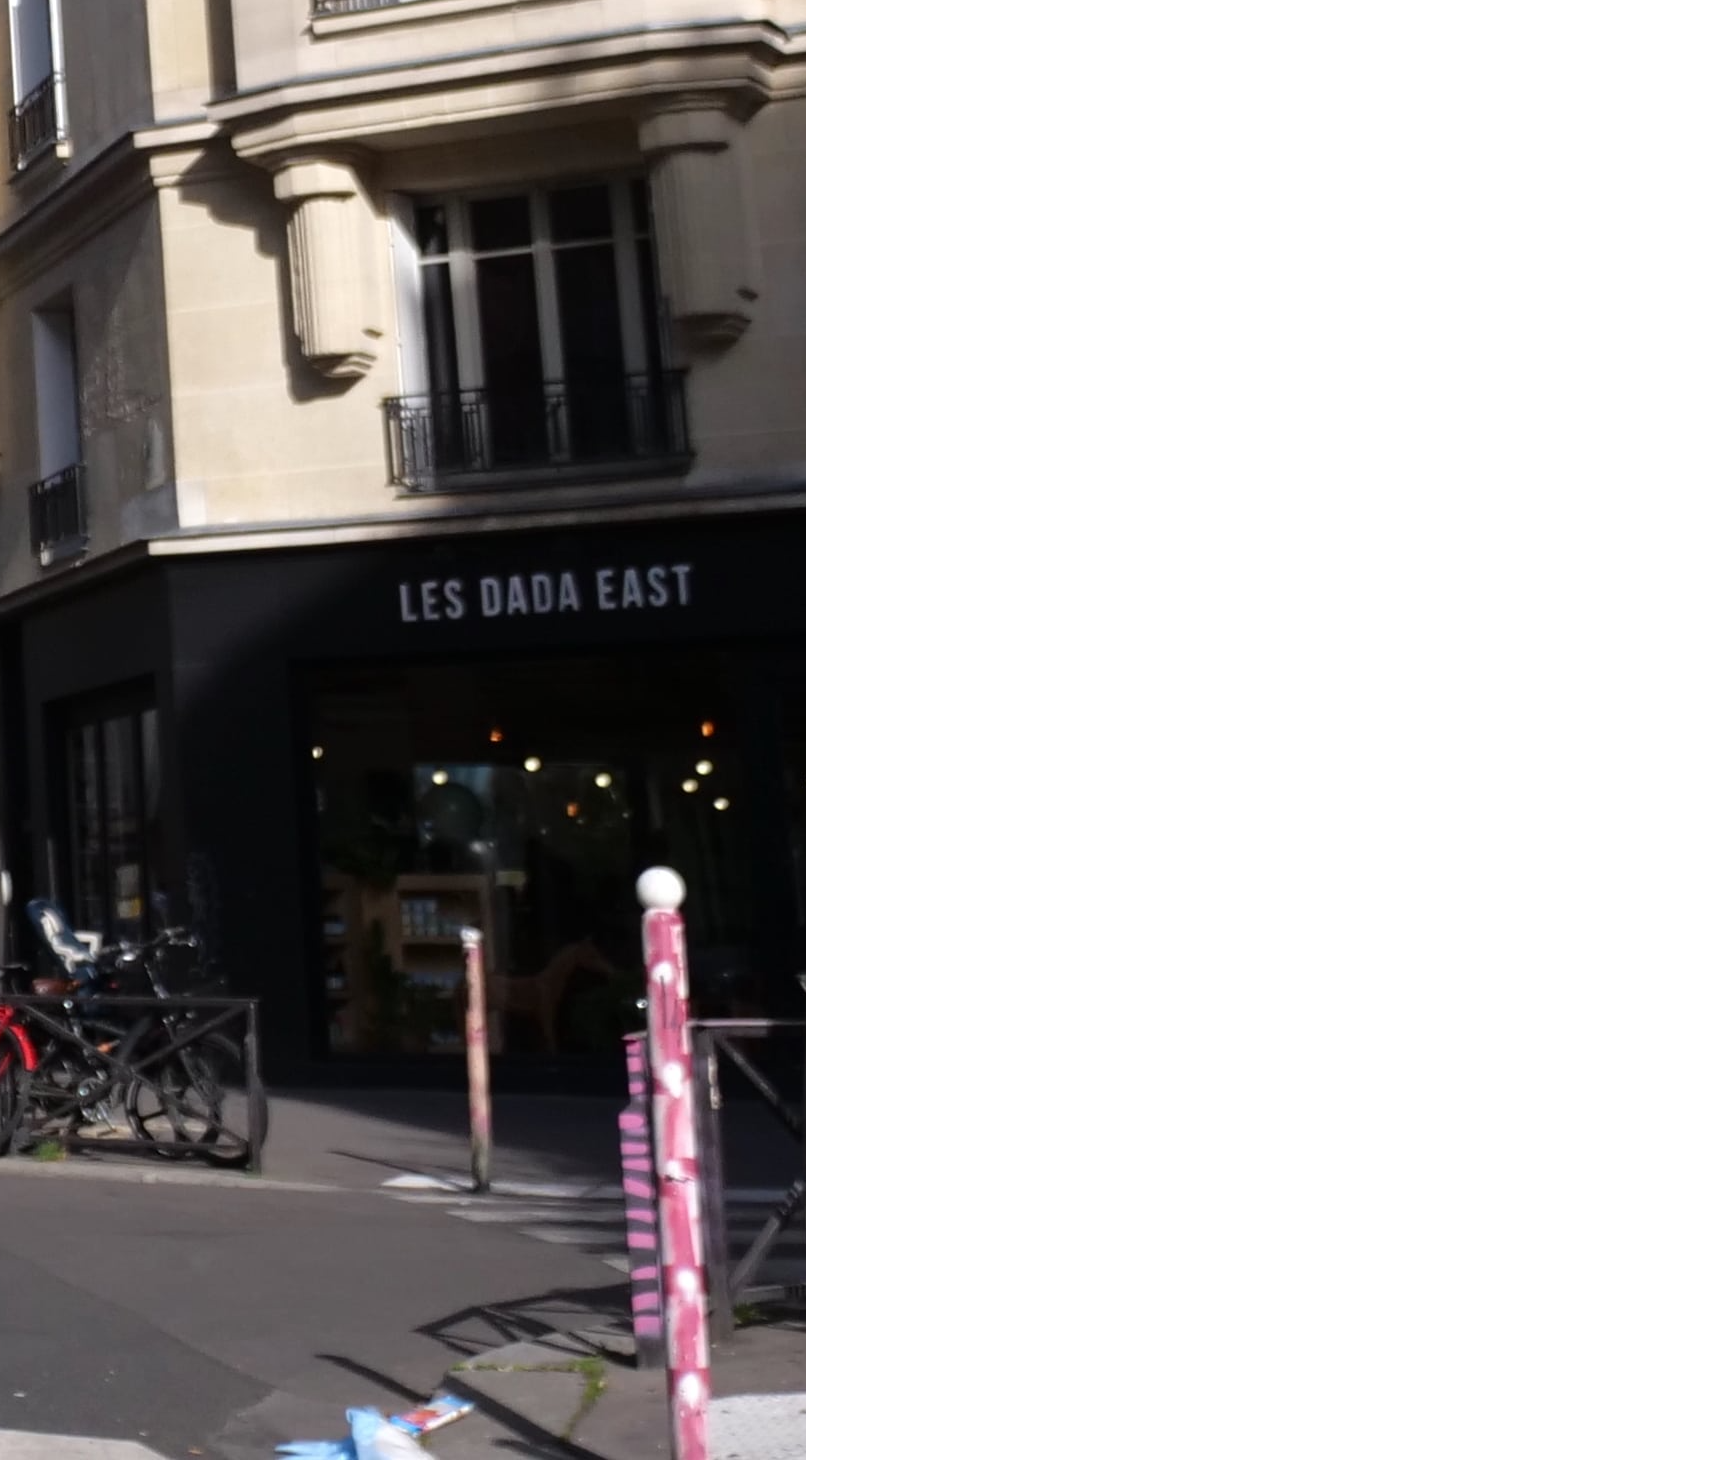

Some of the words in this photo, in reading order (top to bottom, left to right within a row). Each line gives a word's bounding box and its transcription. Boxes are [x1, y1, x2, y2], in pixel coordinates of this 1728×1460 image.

[399, 580, 464, 622] LES
[480, 571, 581, 617] DADA
[596, 564, 694, 610] EAST
